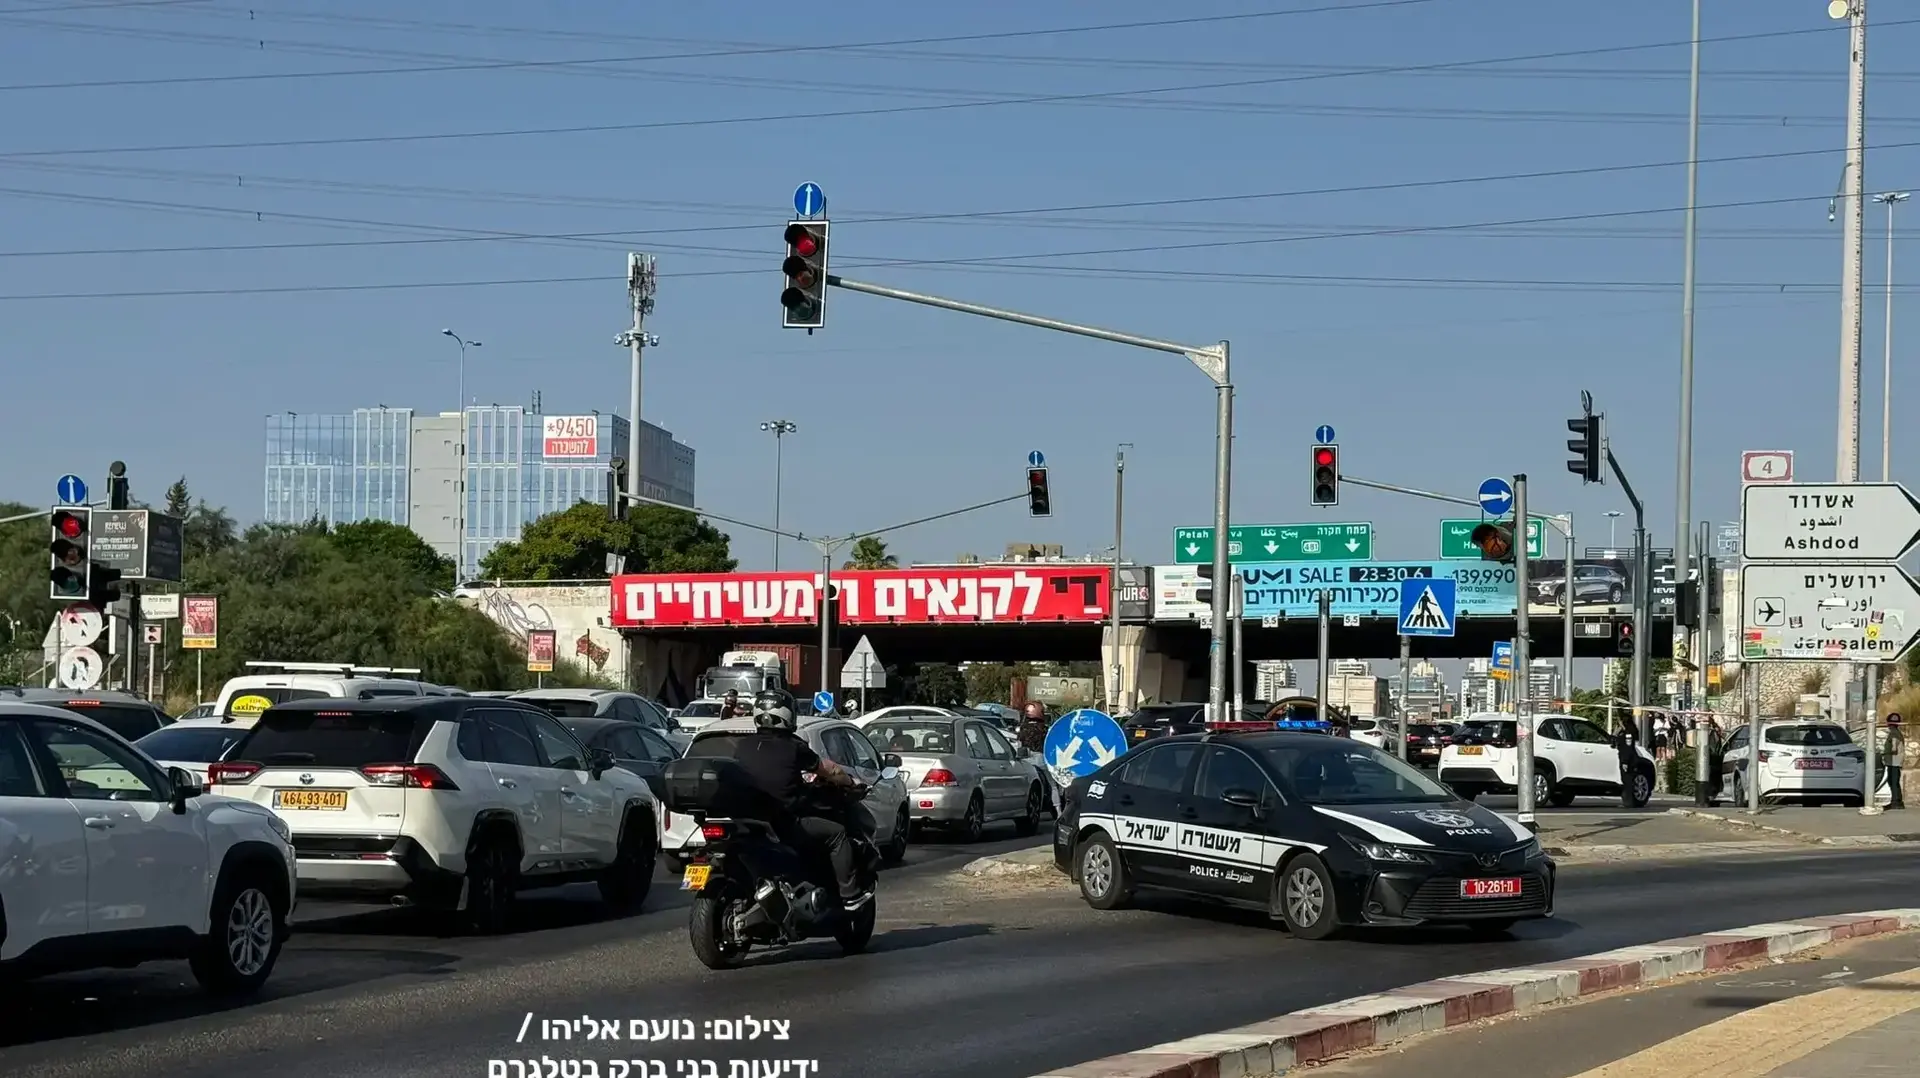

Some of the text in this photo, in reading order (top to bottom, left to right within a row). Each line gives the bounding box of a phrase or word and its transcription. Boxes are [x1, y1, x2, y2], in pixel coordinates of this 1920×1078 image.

[552, 439, 589, 454] להשכרה
[1762, 460, 1772, 474] 4
[1789, 495, 1854, 508] אשדוד
[1179, 530, 1209, 539] Petah
[1346, 526, 1367, 534] פתח
[1304, 542, 1318, 550] 481
[1784, 536, 1859, 549] Ashdod
[1243, 568, 1291, 584] UMI
[1300, 567, 1343, 583] SALE
[1452, 569, 1515, 585] 139,990
[1804, 573, 1886, 588] ירושלים
[874, 571, 1043, 620] לקנאים
[1244, 587, 1399, 605] מכירות מיוחדים
[1263, 616, 1277, 625] 5.5
[1345, 615, 1358, 624] 5.5
[1794, 637, 1894, 650] Jerusalem
[1125, 820, 1241, 854] משטרת ישראל
[1446, 828, 1492, 836] POLICE
[1189, 865, 1219, 878] POLICE
